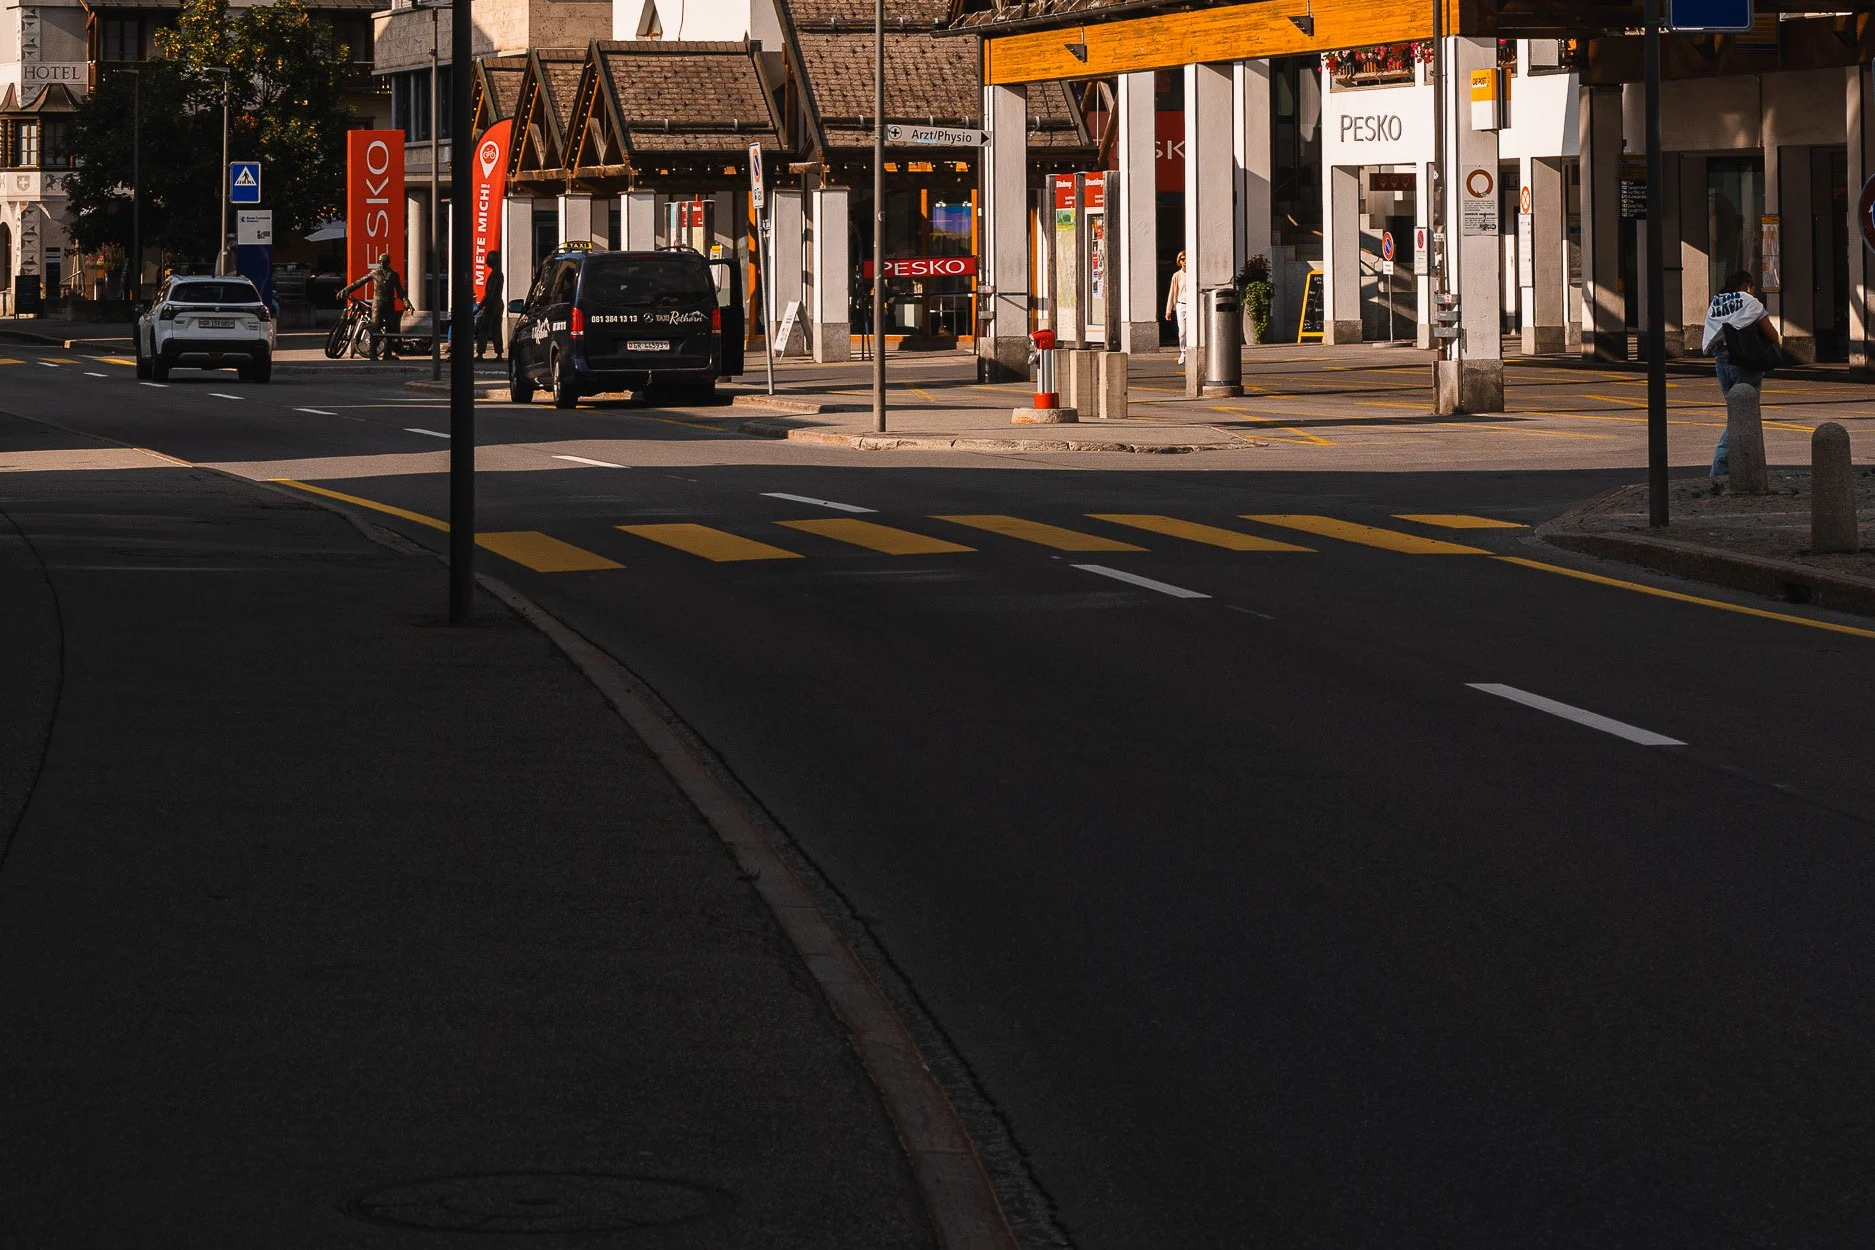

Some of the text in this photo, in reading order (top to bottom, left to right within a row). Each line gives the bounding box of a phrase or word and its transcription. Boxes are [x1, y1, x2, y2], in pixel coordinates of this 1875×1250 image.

[23, 65, 81, 80] HOTEL
[1340, 114, 1402, 143] PESKO
[911, 129, 972, 145] Arzt/Physio
[365, 140, 389, 302] ESKO
[475, 182, 491, 286] MIETE MICH!
[591, 315, 638, 323] 081 384 13 13
[669, 310, 704, 326] Rothorn
